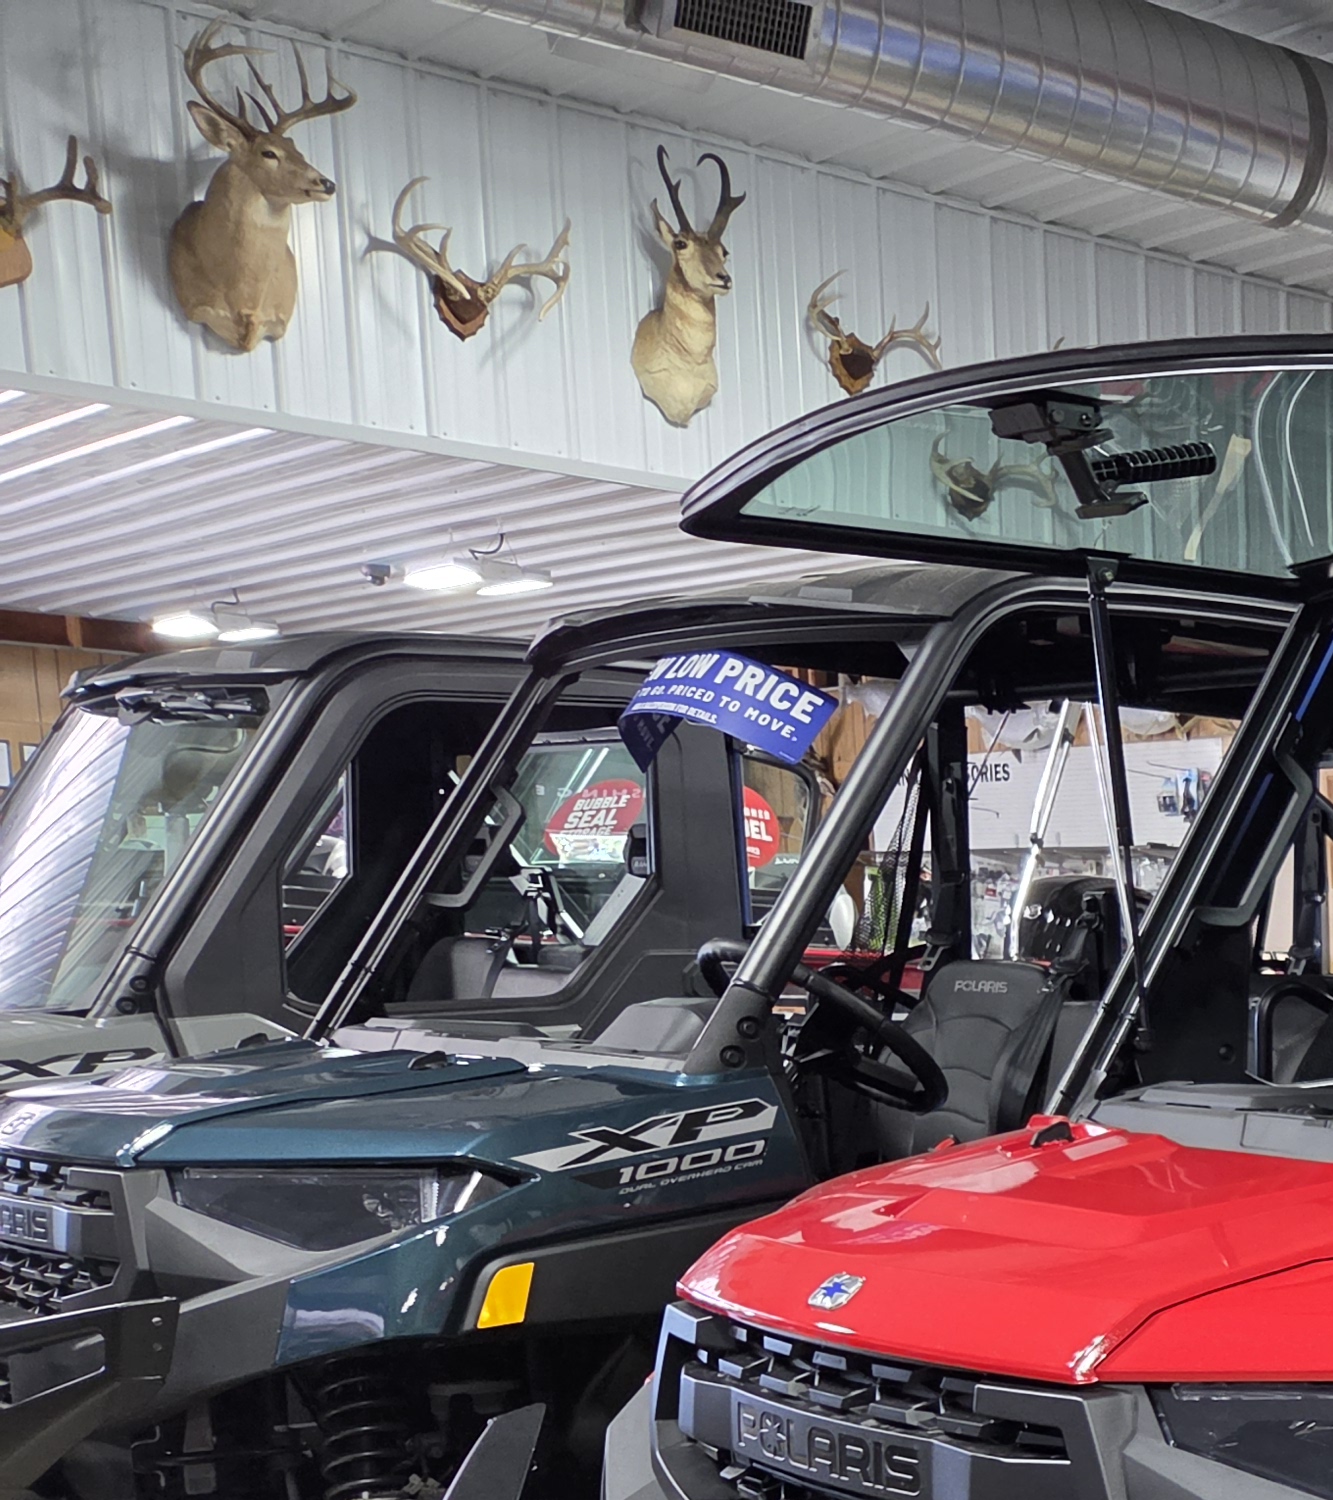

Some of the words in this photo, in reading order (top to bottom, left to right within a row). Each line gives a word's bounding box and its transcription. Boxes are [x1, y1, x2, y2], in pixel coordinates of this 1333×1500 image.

[665, 653, 720, 679] LOW
[713, 657, 825, 725] PRICE
[668, 684, 716, 703] PRICED
[719, 695, 741, 713] TO
[744, 707, 798, 742] MOVE.
[967, 762, 1011, 783] ORIES
[563, 808, 618, 829] SEAL
[573, 794, 631, 811] BUBBLE
[954, 979, 1009, 994] POLARIS
[0, 1046, 159, 1082] XP
[555, 1098, 771, 1170] XP
[618, 1139, 766, 1185] 1000
[618, 1182, 657, 1195] DUAL
[660, 1165, 732, 1186] OVERHEAD
[733, 1158, 764, 1171] CAM
[737, 1400, 922, 1497] POLARIS
